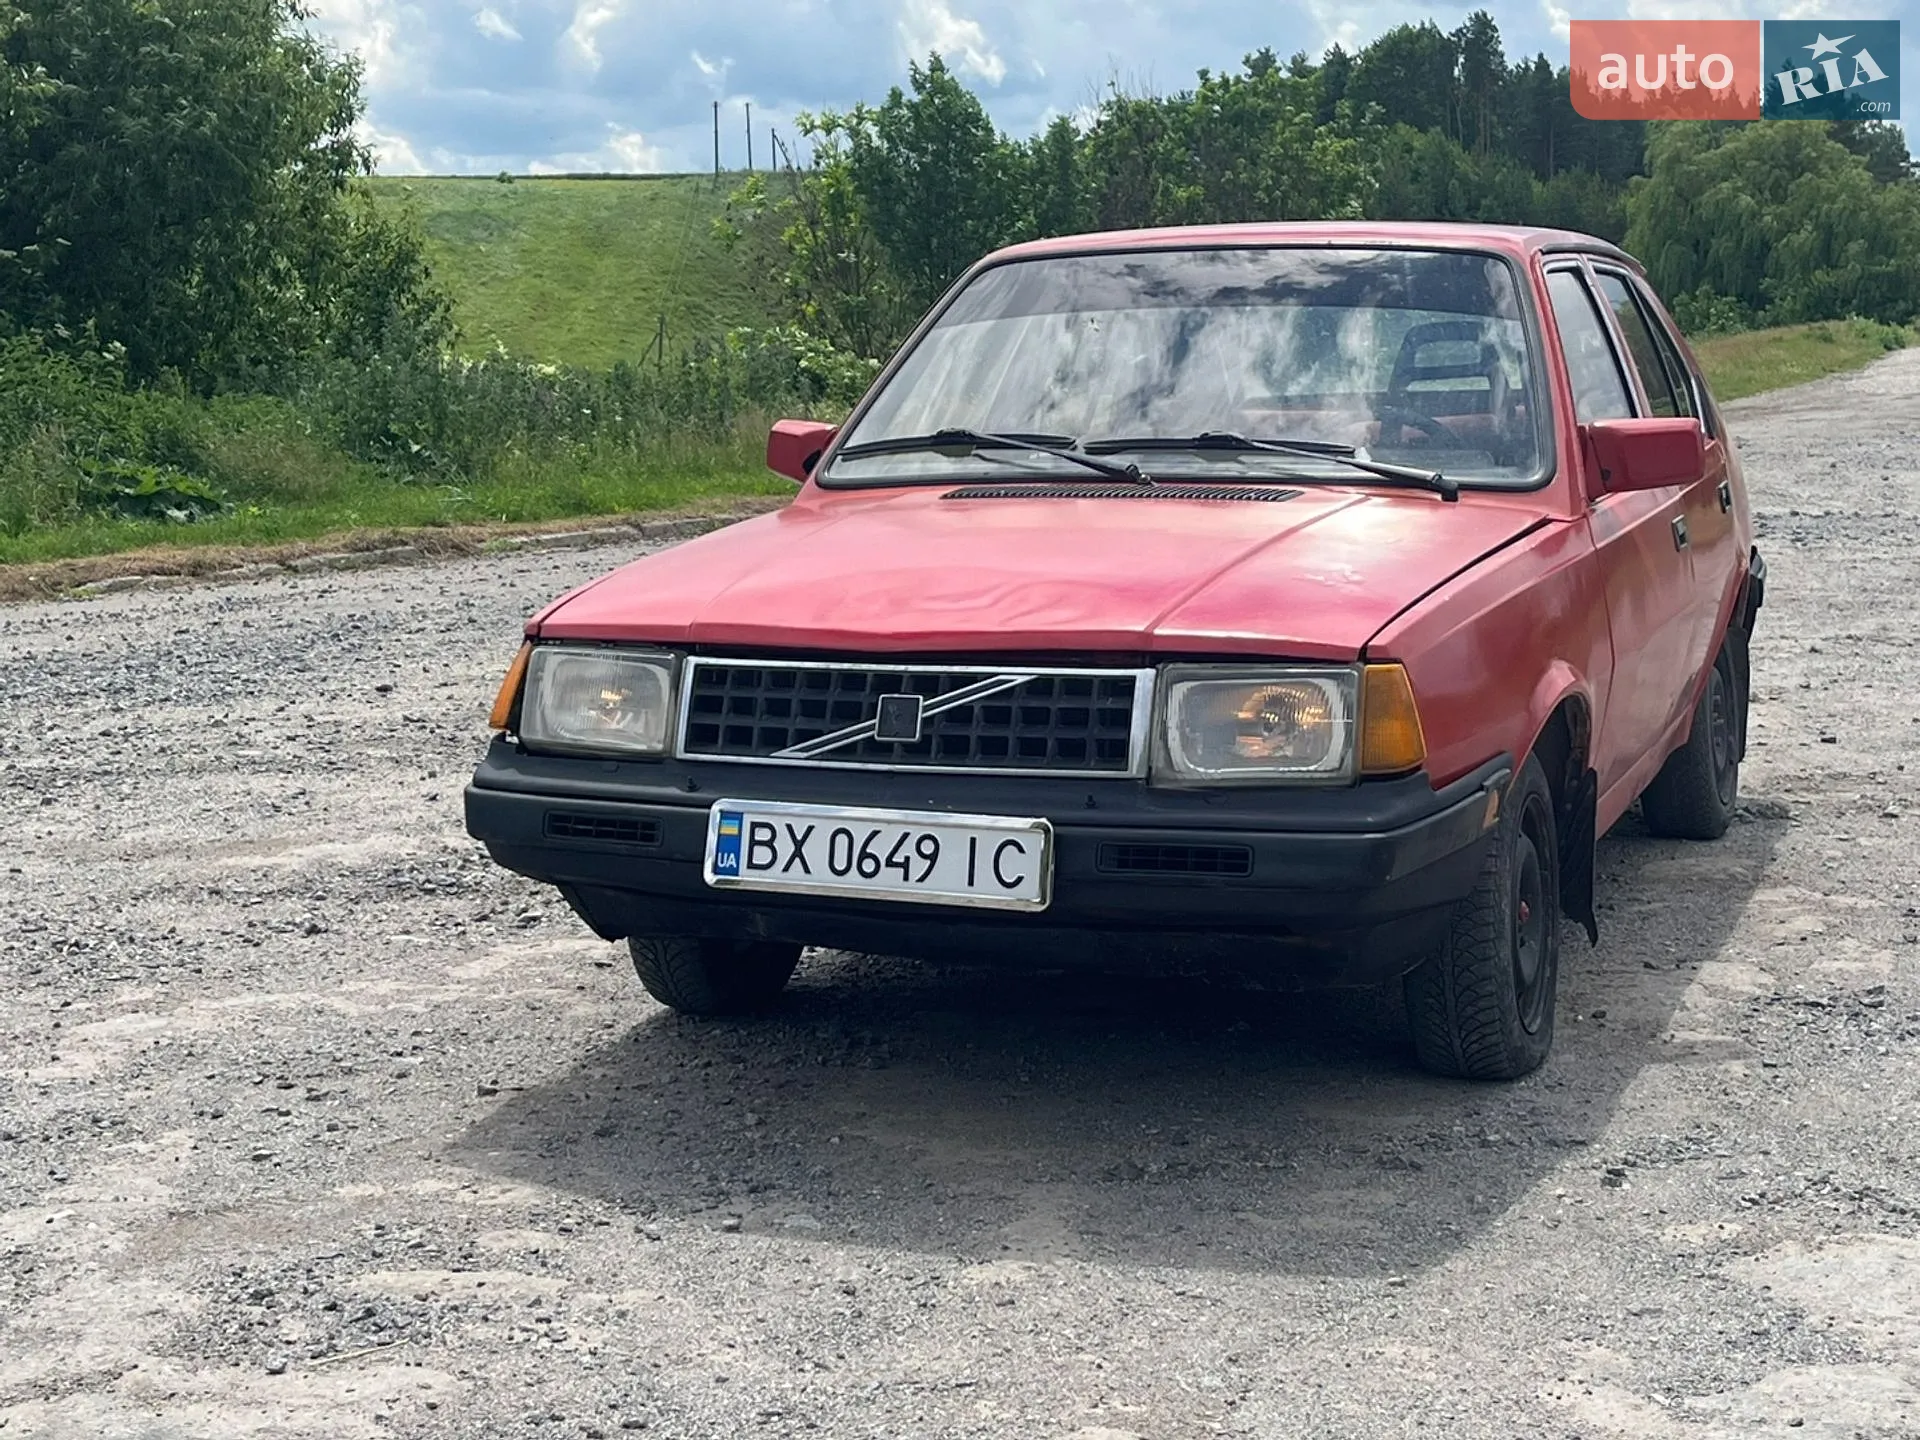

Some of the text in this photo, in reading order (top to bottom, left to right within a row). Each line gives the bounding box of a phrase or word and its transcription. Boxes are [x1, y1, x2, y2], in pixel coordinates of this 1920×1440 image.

[717, 852, 737, 869] UA
[747, 821, 1026, 888] BX 0649 IC
